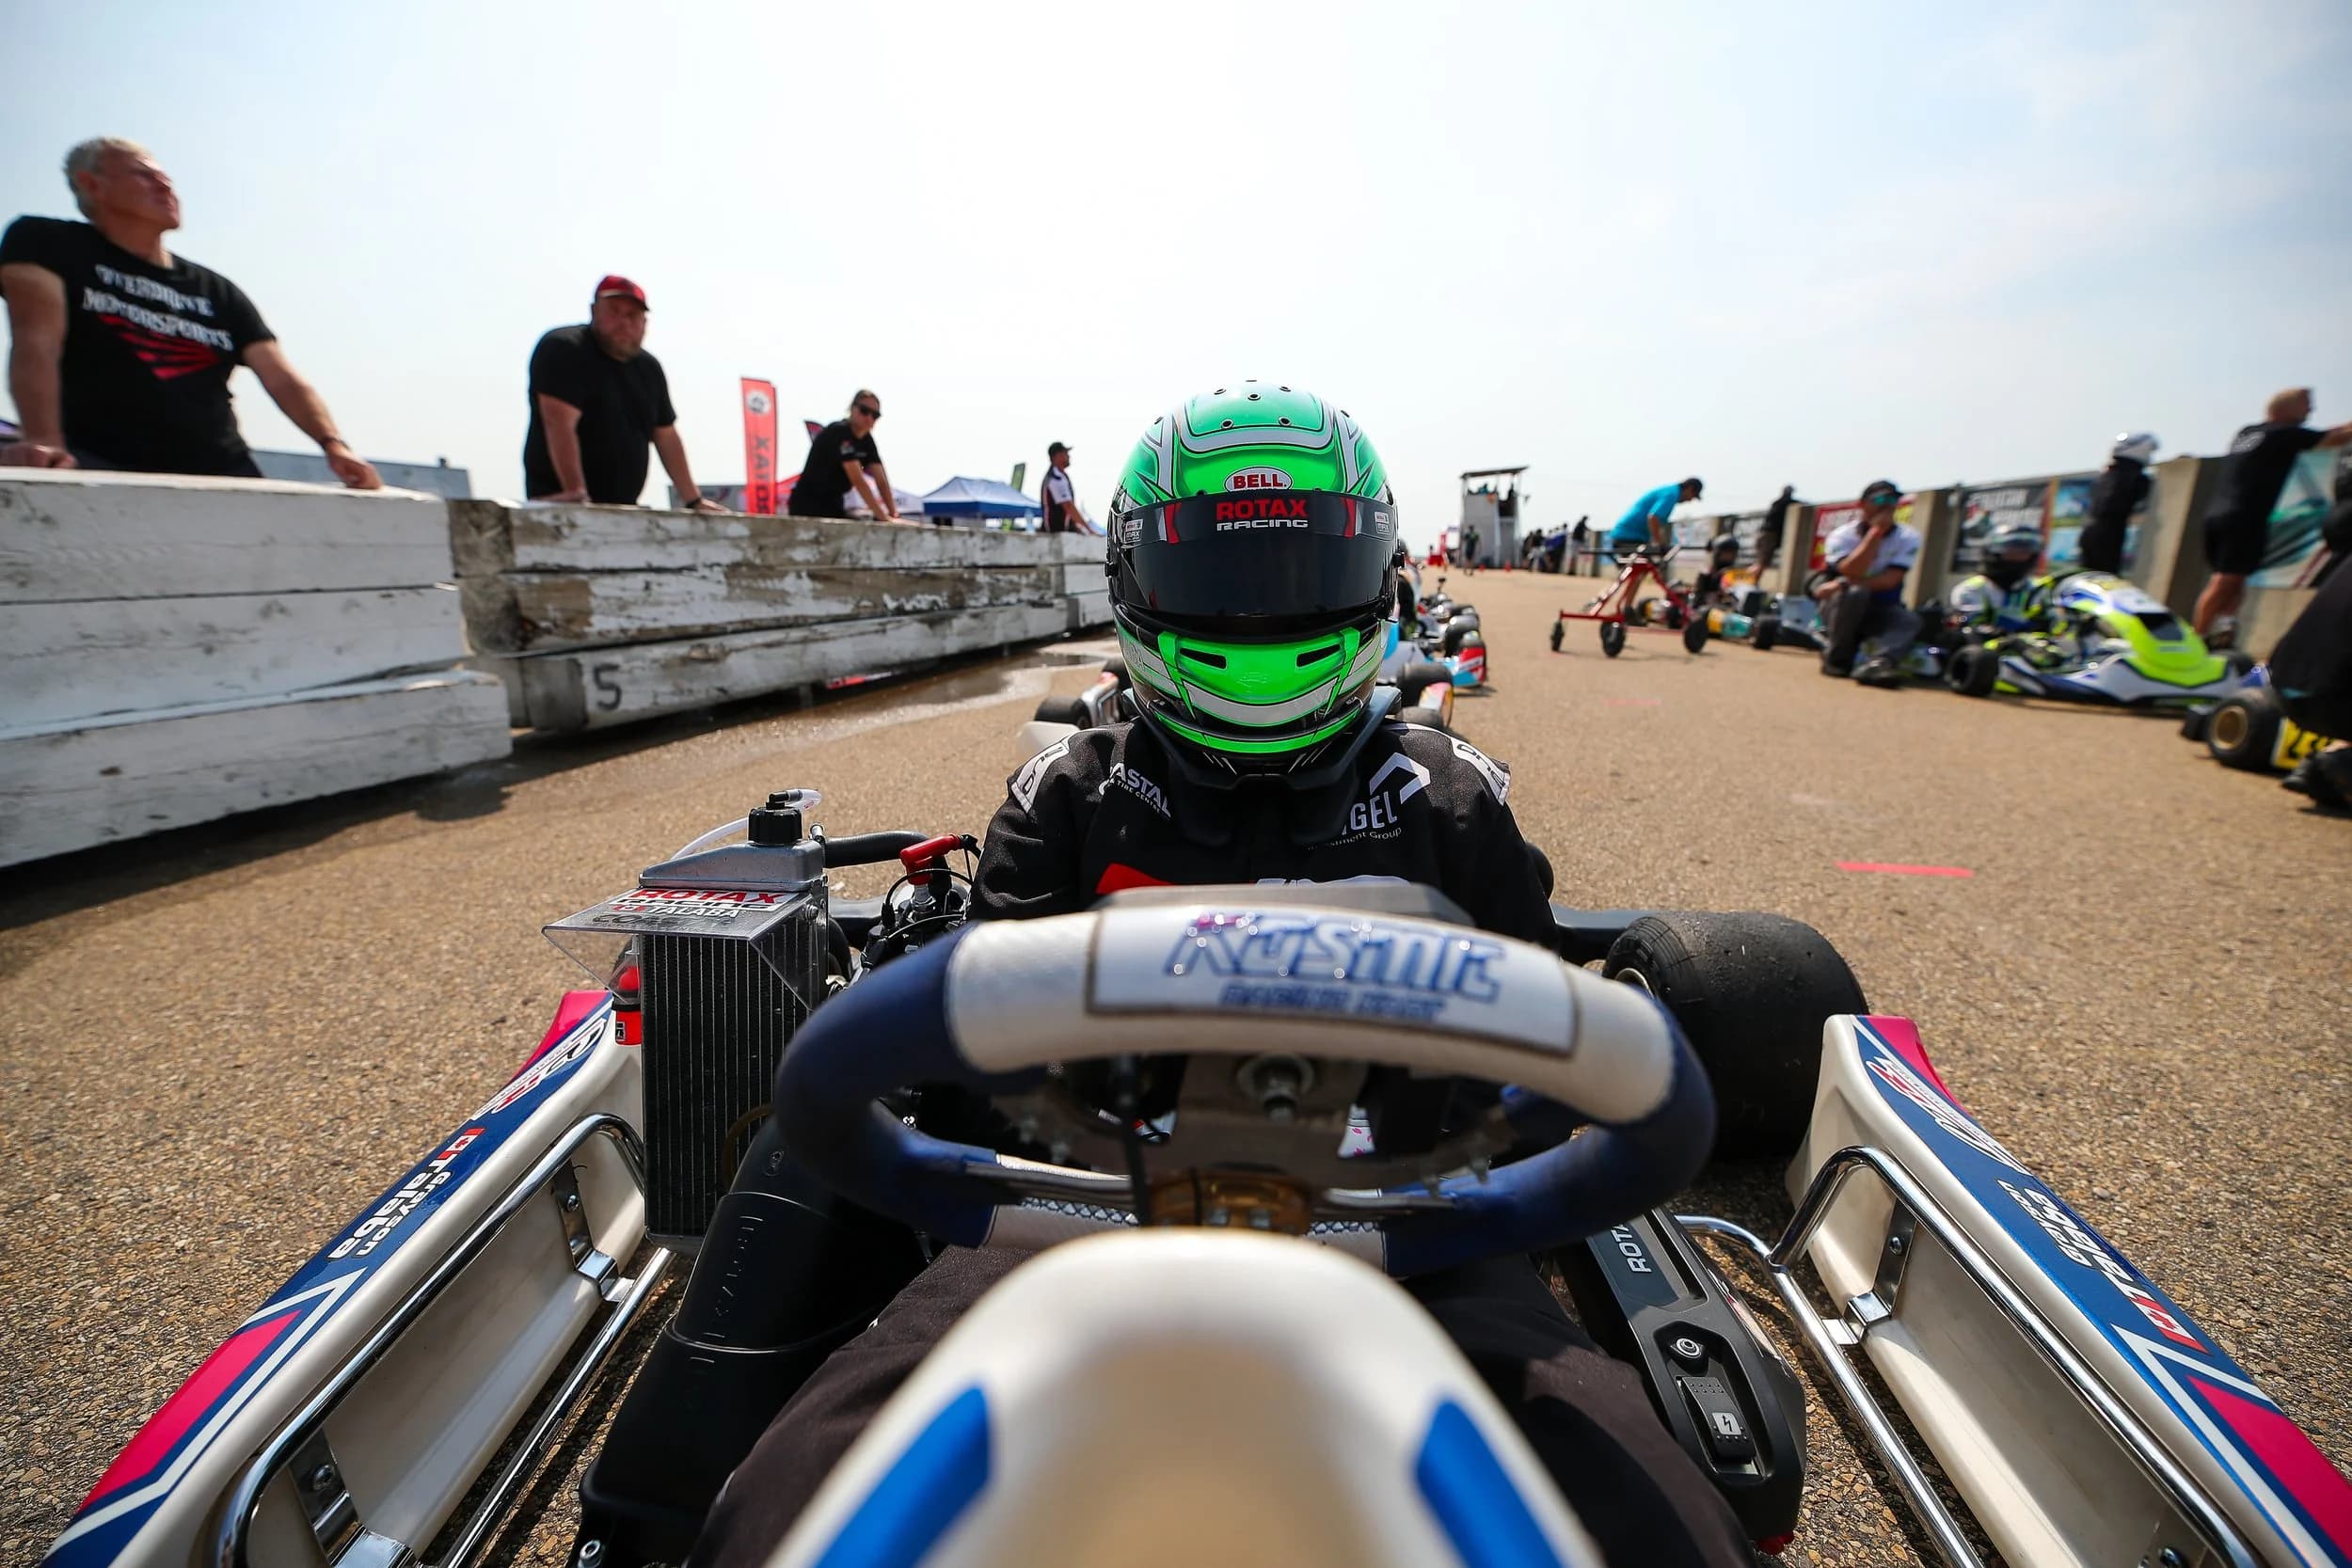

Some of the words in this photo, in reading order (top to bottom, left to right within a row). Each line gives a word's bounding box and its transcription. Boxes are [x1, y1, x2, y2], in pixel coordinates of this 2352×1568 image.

[1233, 474, 1283, 489] BELL
[1216, 499, 1309, 521] ROTAX
[1216, 519, 1309, 531] RACING
[593, 663, 622, 710] 5
[1342, 791, 1398, 835] GEL
[1369, 827, 1403, 840] Group
[614, 898, 773, 910] RACING
[628, 888, 787, 904] ROTAX
[647, 906, 739, 919] TALABA
[328, 1152, 452, 1260] Talaba
[356, 1170, 453, 1259] Grayson
[1997, 1180, 2091, 1268] Grayson
[2025, 1187, 2155, 1301] Talaba
